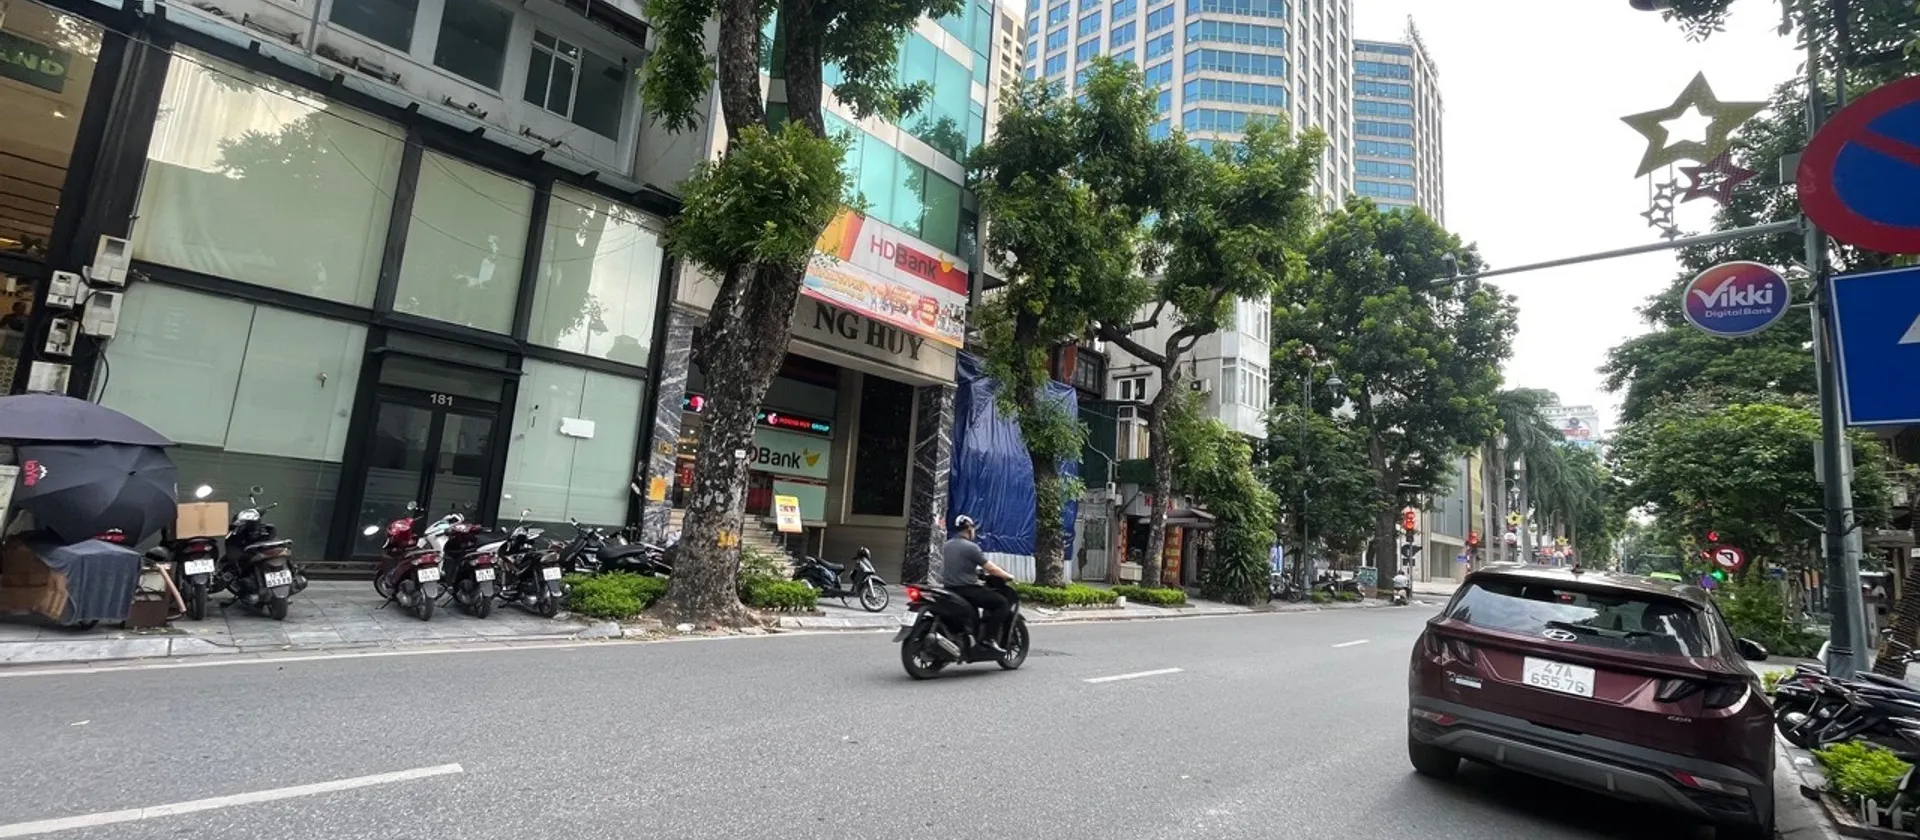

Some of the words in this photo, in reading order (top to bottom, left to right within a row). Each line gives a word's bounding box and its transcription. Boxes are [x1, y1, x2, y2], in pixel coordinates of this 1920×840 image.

[870, 234, 937, 279] HDBank
[1692, 276, 1773, 308] Vikki
[430, 393, 453, 406] 181
[1543, 662, 1572, 678] 47A
